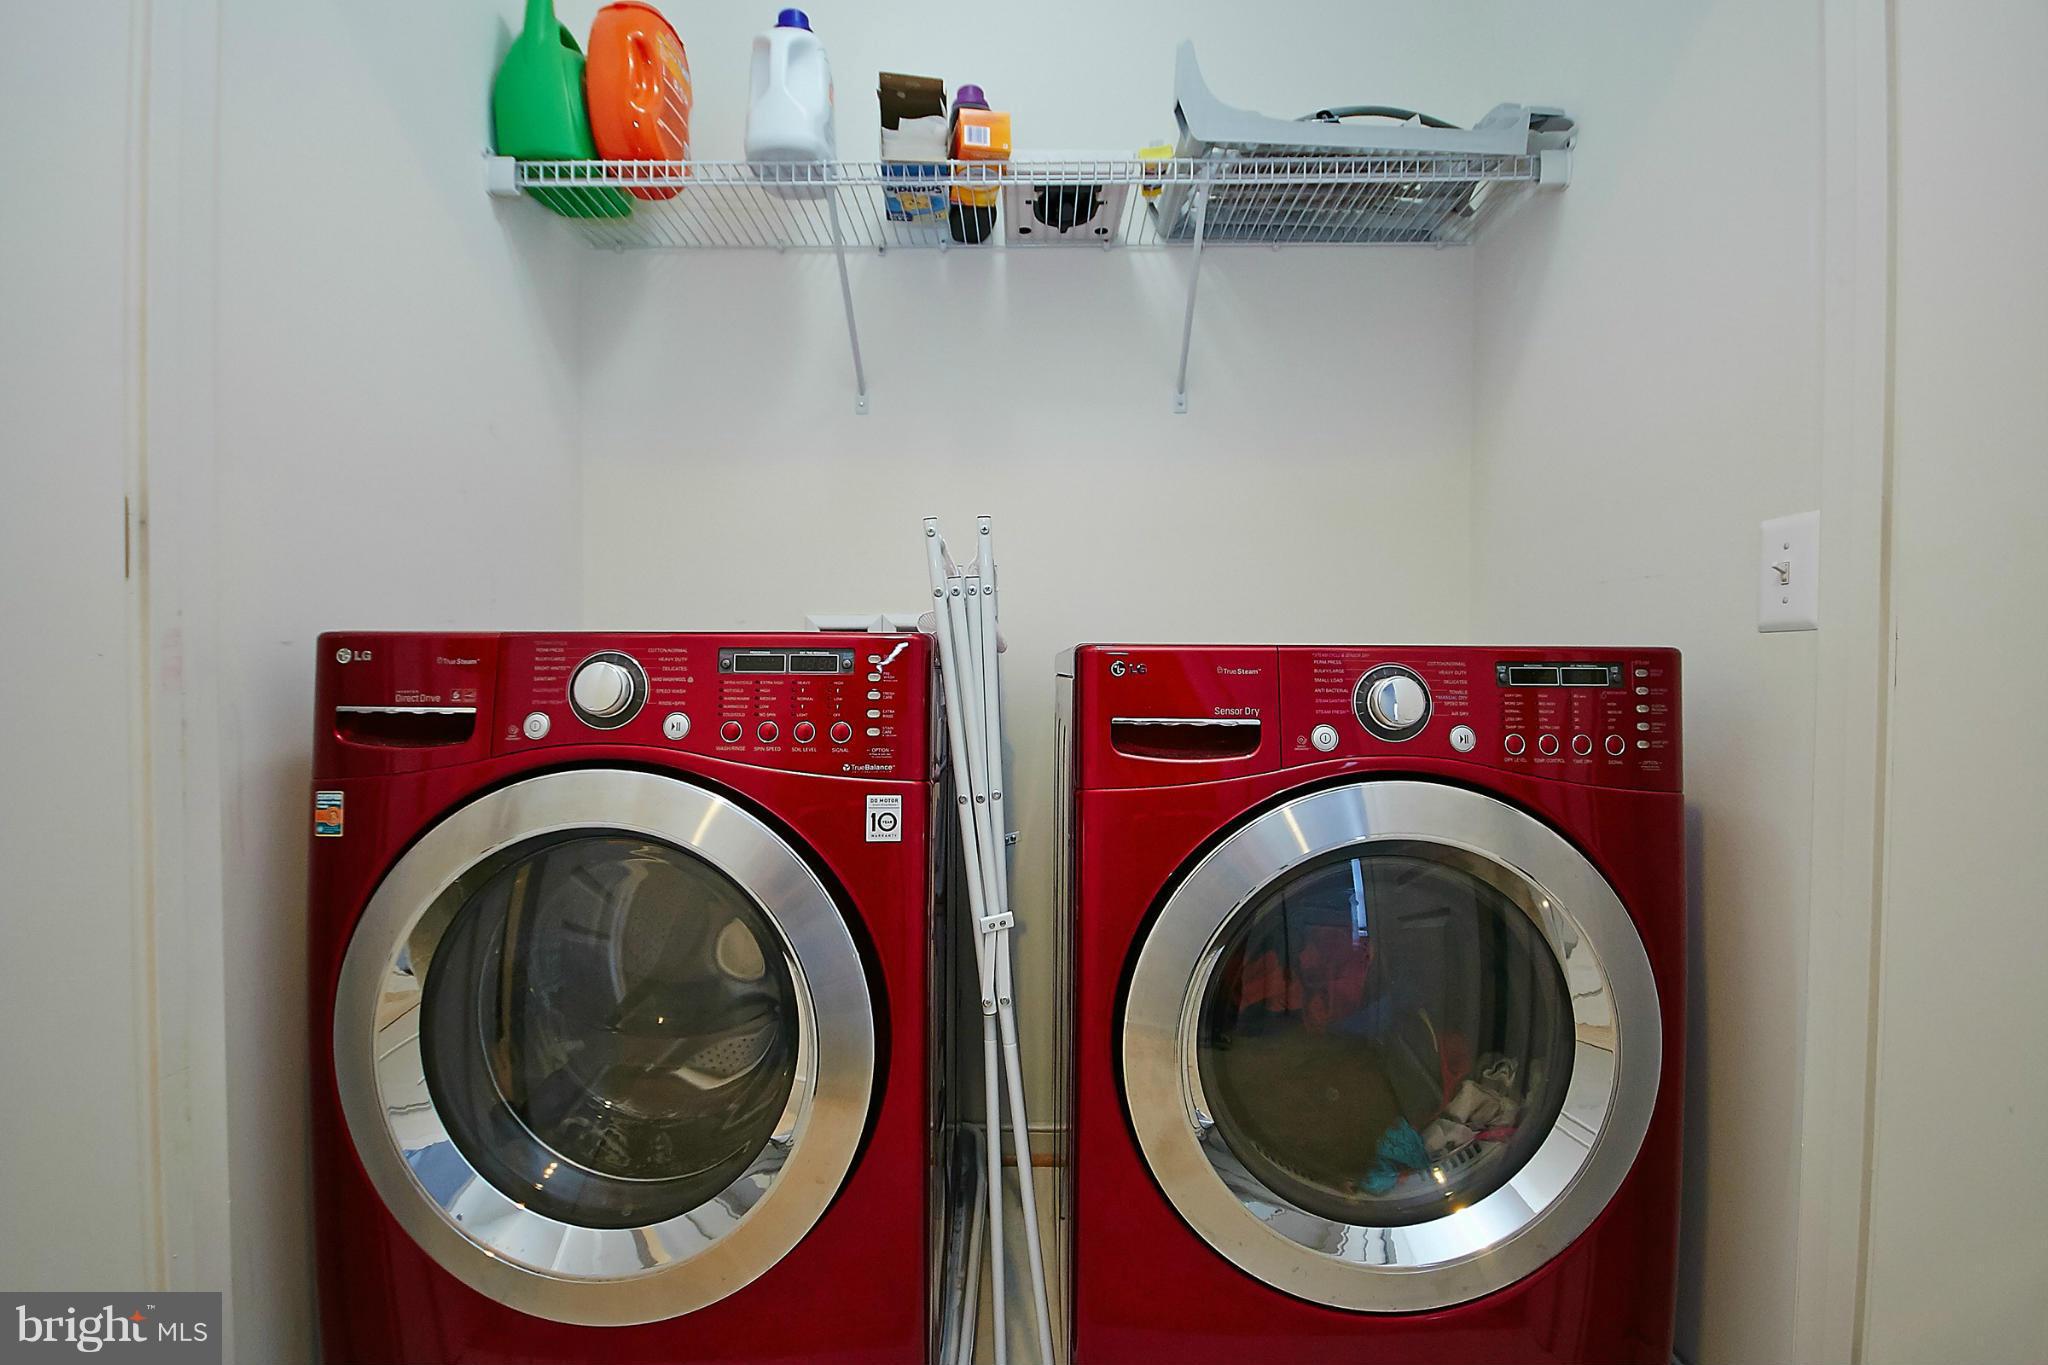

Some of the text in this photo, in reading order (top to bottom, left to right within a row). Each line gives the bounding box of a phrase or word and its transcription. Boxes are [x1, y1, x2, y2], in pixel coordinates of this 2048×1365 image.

[354, 651, 372, 661] LG
[1129, 663, 1148, 673] LG
[395, 694, 420, 702] Direct
[420, 694, 440, 702] Drive
[1214, 706, 1260, 717] Sensor Dry
[870, 812, 898, 832] 10
